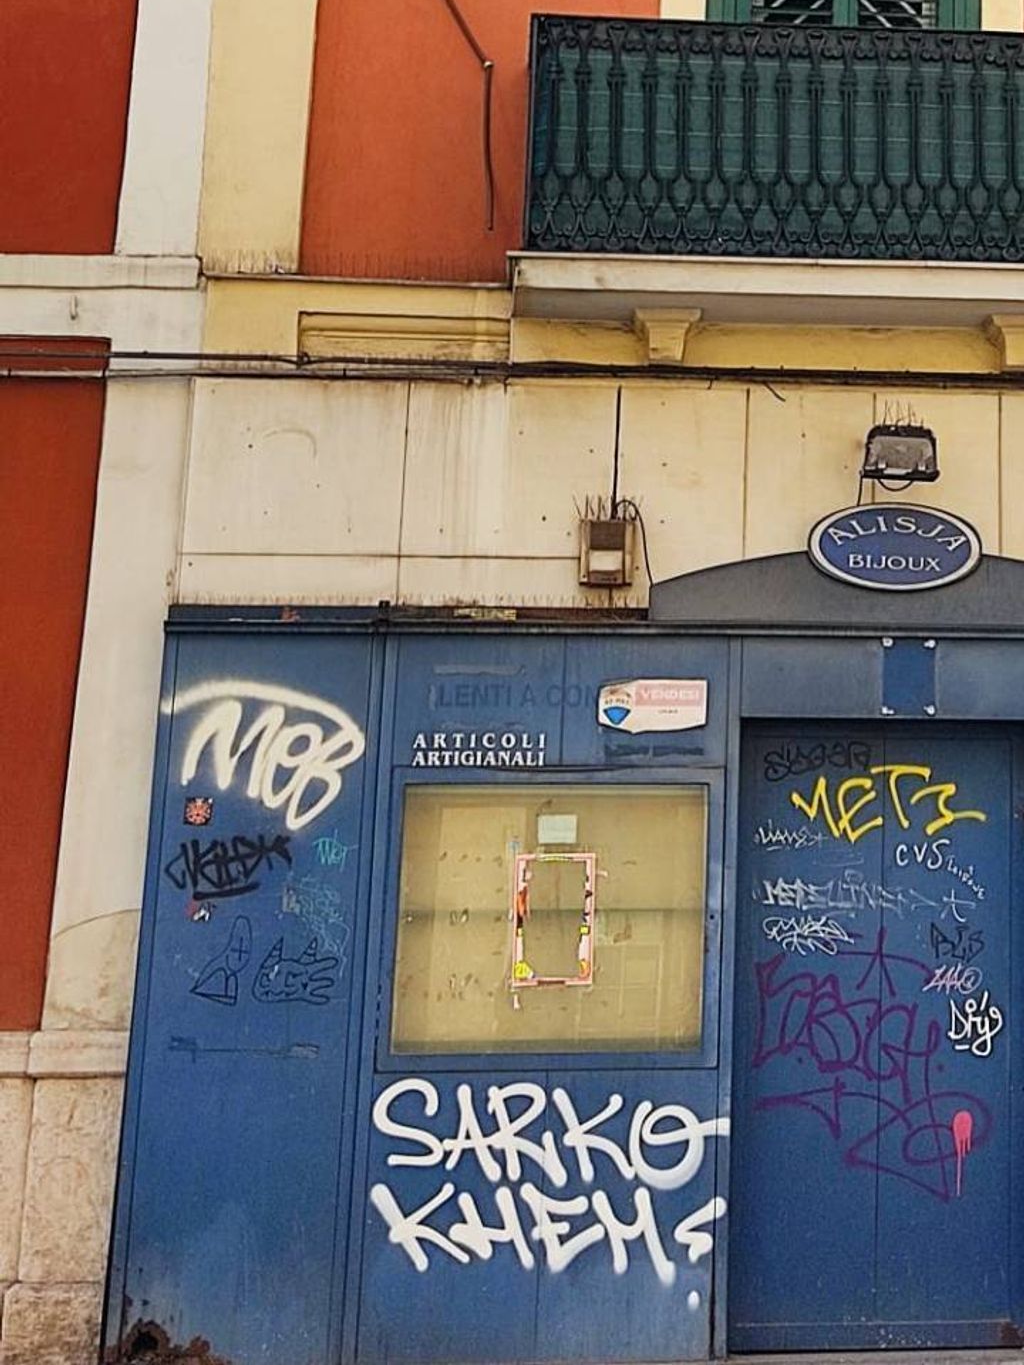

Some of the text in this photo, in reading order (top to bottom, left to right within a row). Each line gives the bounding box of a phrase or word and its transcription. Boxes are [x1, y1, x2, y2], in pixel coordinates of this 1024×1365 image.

[827, 516, 967, 551] ALISJA
[848, 553, 942, 572] BIJOUX
[413, 733, 545, 749] ARTICOLI
[412, 750, 545, 766] ARTIGIANALI
[372, 1077, 731, 1191] SARKO
